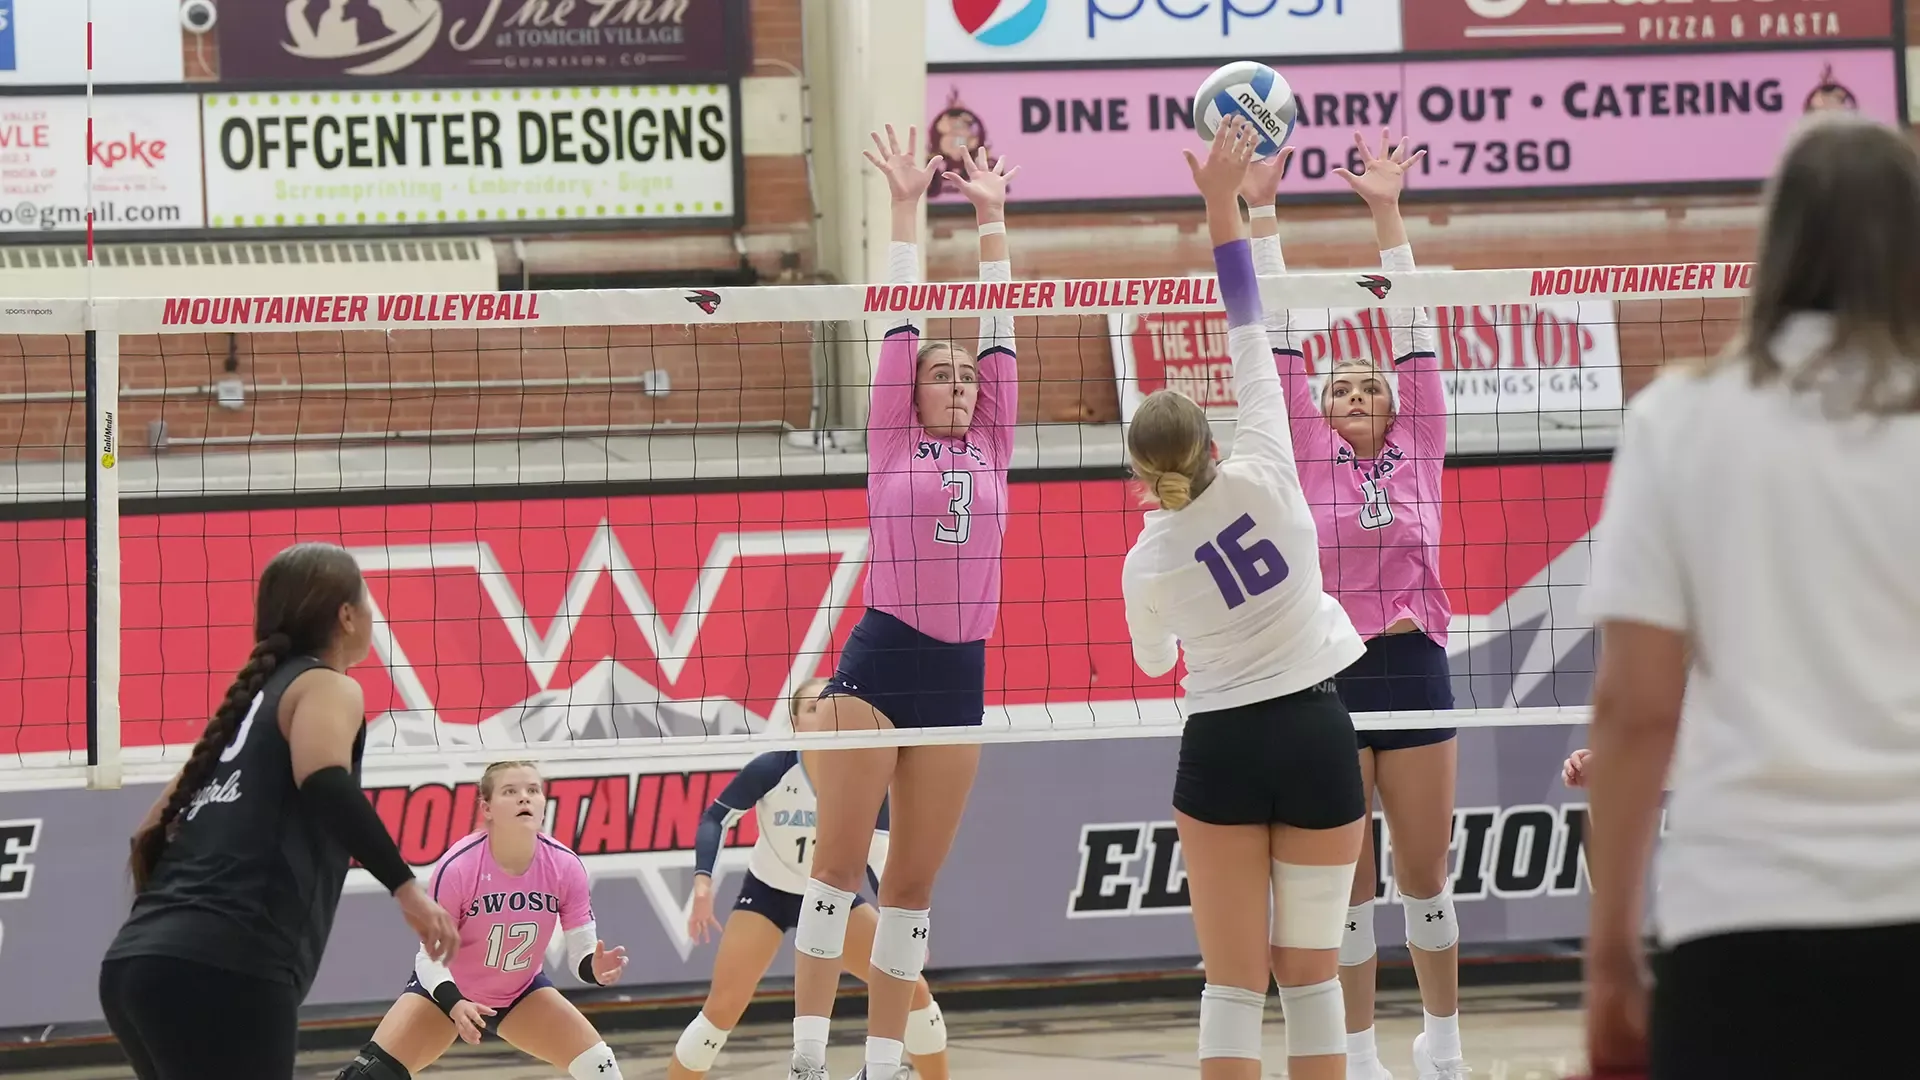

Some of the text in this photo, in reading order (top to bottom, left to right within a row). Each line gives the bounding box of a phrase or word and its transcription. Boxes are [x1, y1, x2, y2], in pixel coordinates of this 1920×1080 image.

[516, 27, 600, 47] TOMICHI
[604, 26, 684, 46] VILLAGE
[1639, 12, 1840, 39] PIZZA & PASTA
[620, 52, 647, 66] CO
[1021, 95, 1129, 133] DINE
[1149, 93, 1194, 131] IN
[1419, 85, 1513, 123] OUT
[1563, 79, 1784, 119] CATERING
[1238, 92, 1281, 137] molten
[220, 104, 727, 171] OFFCENTER DESIGNS
[275, 172, 673, 200] Screenprinting Embroidery Signs
[863, 278, 1218, 313] MOUNTAINEER VOLLEYBALL
[1530, 264, 1716, 297] MOUNTAINEER
[162, 292, 540, 326] MOUNTAINEER VOLLEYBALL
[1146, 320, 1192, 361] THE
[1301, 303, 1594, 377] POWRSTOP
[104, 412, 113, 453] GoldMedal
[934, 470, 973, 544] 3
[1194, 512, 1290, 610] 16
[466, 891, 560, 917] SWOSU
[484, 921, 538, 973] 12
